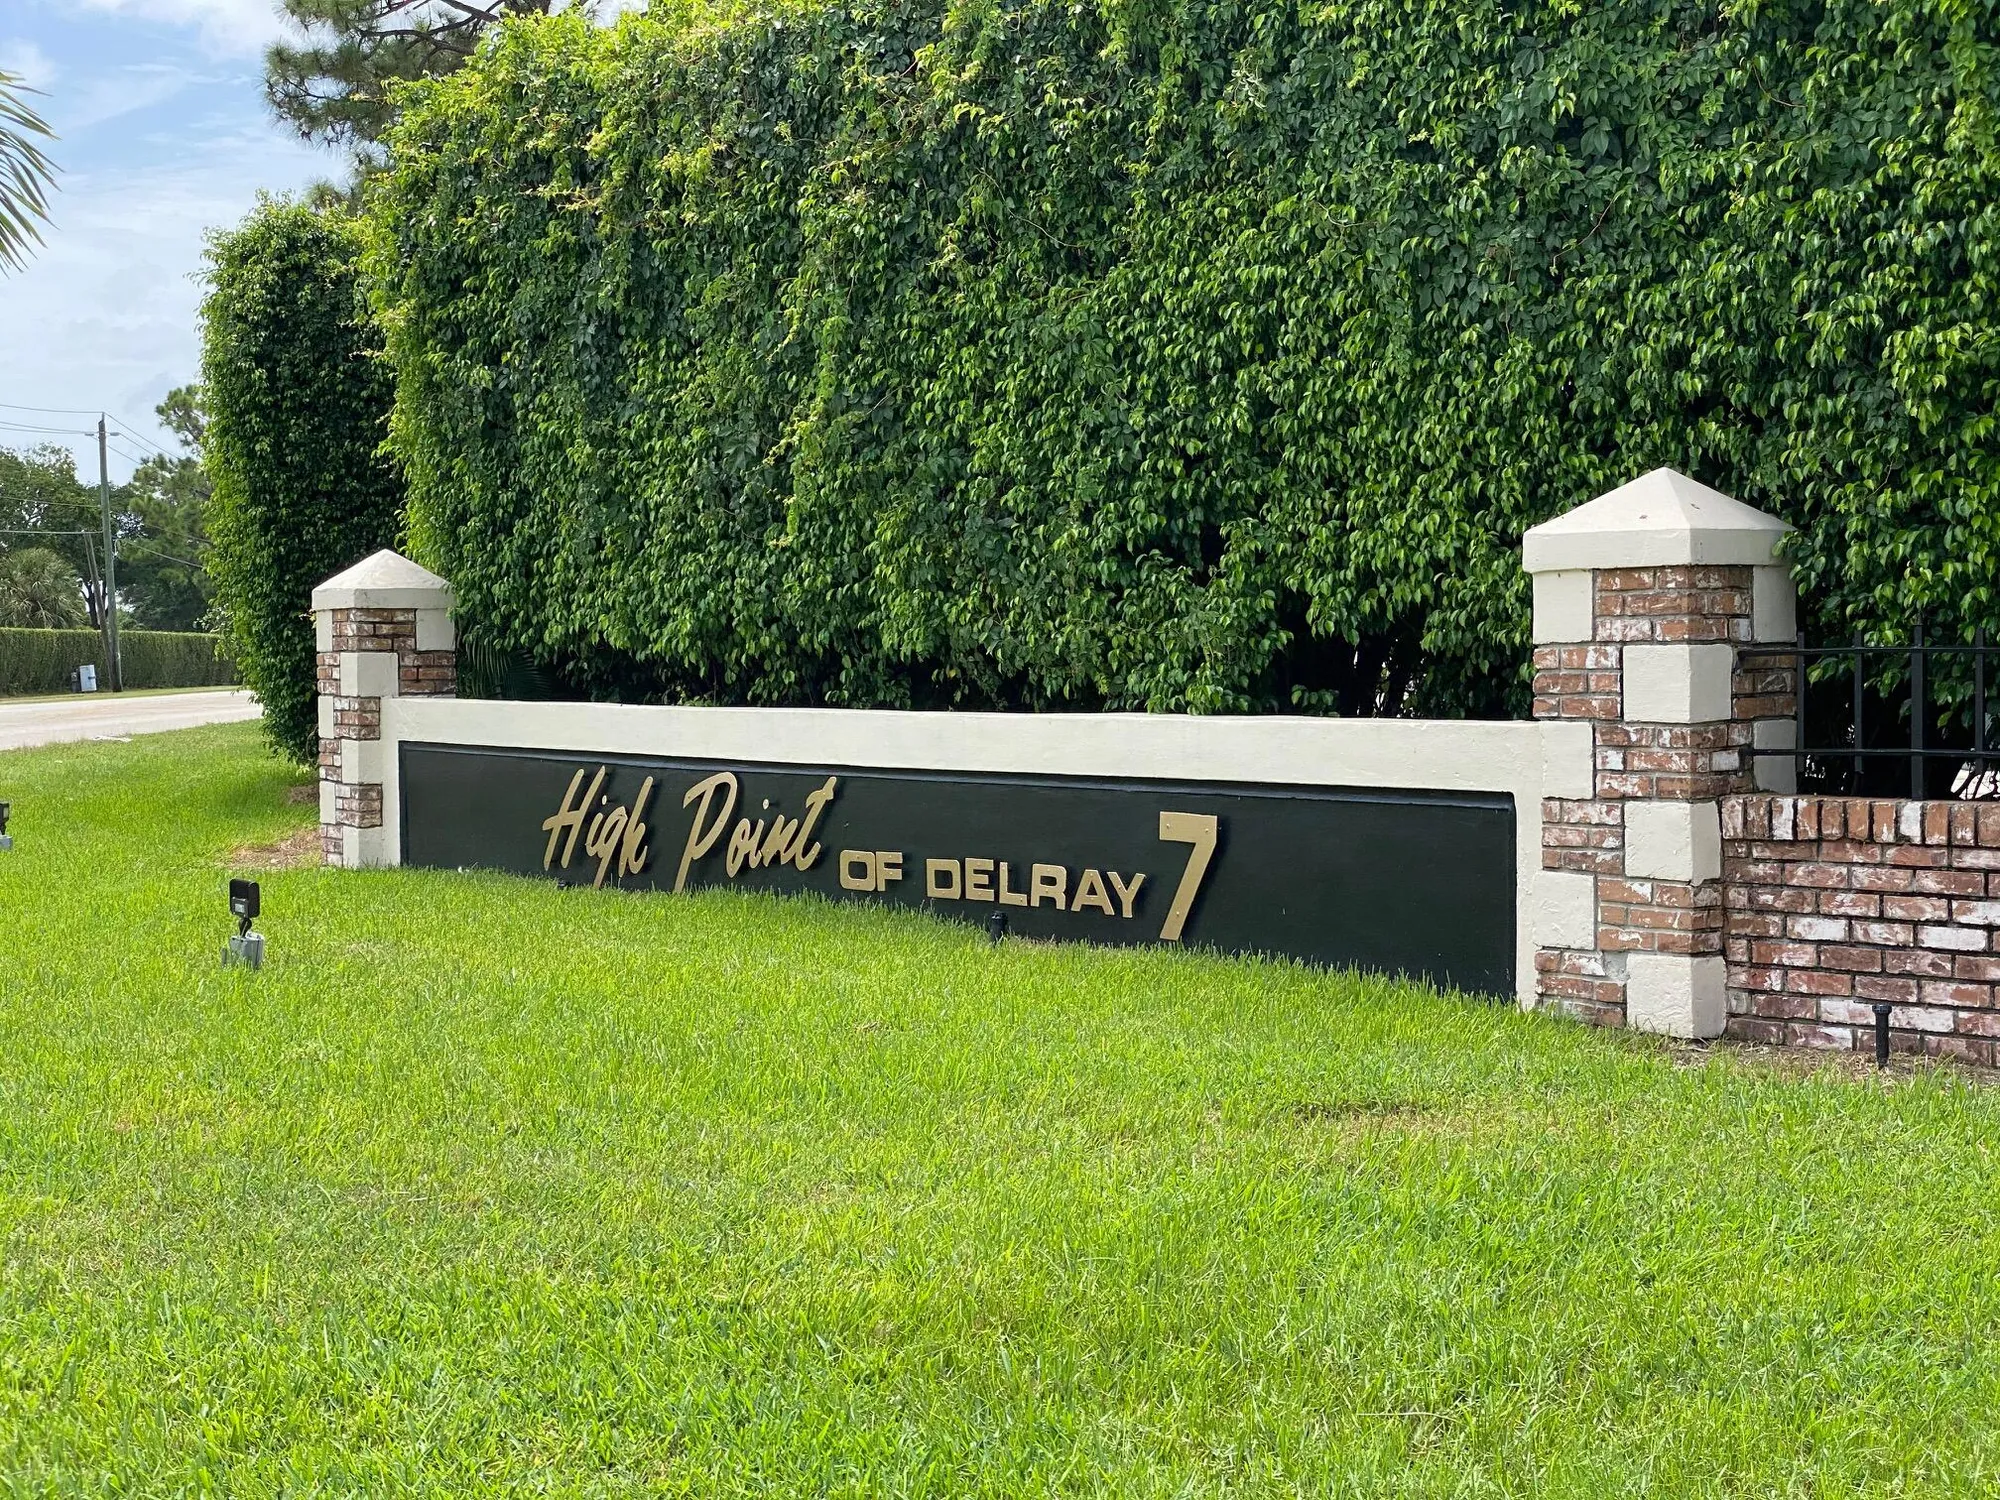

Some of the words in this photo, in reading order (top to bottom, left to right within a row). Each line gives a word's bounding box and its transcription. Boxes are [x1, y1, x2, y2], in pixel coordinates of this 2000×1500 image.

[542, 765, 653, 889] High
[674, 771, 837, 894] Point
[839, 849, 903, 892] OF
[926, 857, 1146, 918] DELRAY
[1159, 811, 1218, 942] 7
